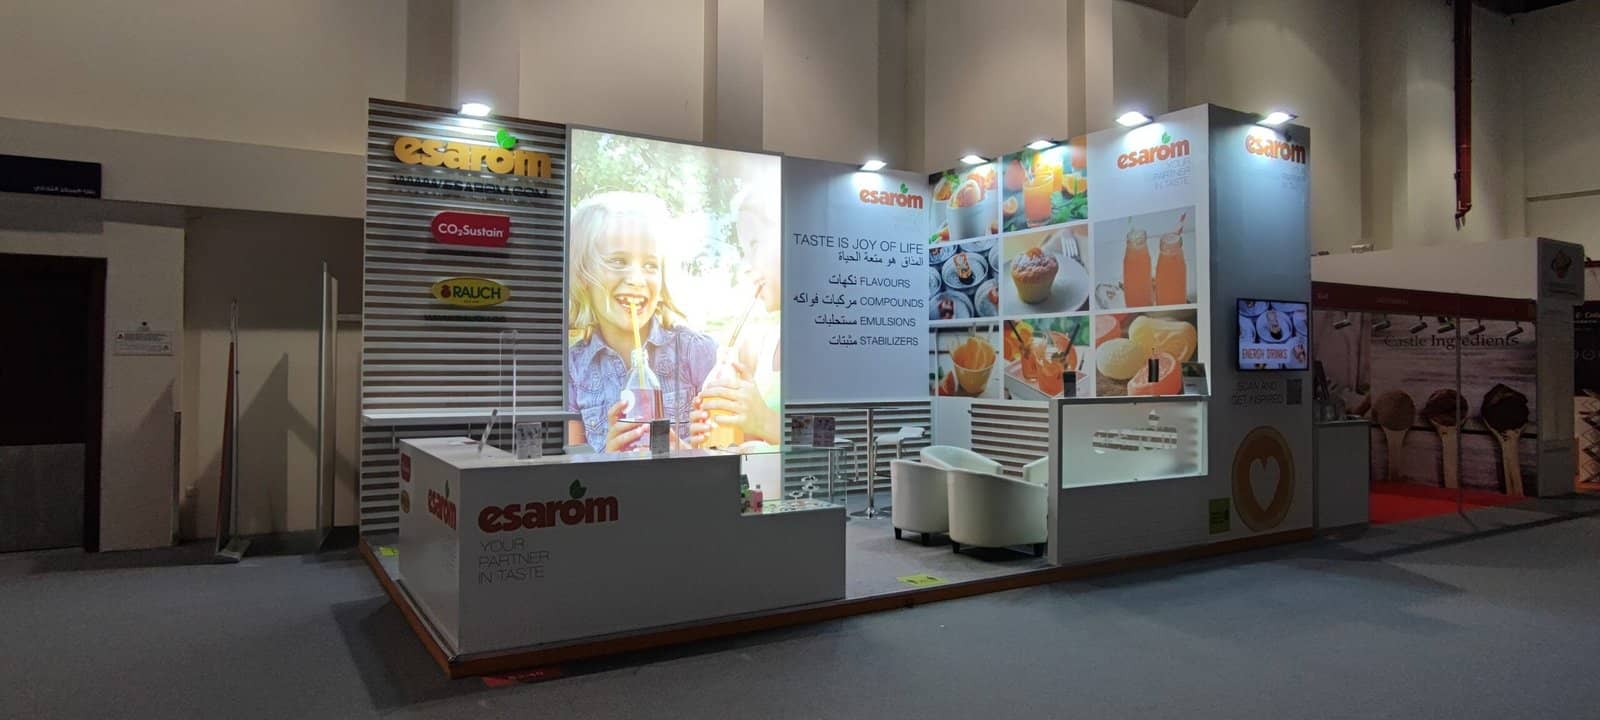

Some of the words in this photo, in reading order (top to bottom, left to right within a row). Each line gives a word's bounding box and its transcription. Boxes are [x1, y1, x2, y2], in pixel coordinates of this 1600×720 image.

[1117, 139, 1190, 169] esarom
[1245, 134, 1306, 164] esarom
[393, 136, 552, 178] esarom
[859, 189, 923, 209] esarom
[793, 233, 834, 247] TASTE
[838, 237, 848, 248] IS
[852, 238, 877, 250] JOY
[880, 240, 896, 251] OF
[900, 242, 923, 254] LIFE
[838, 250, 860, 264] الحياة
[864, 251, 882, 263] متعة
[887, 257, 896, 267] هو
[829, 274, 857, 288] نكهات
[860, 276, 911, 288] FLAVOURS
[453, 286, 502, 299] RAUCH
[793, 292, 819, 307] فواكه
[822, 294, 857, 308] مركبات
[860, 297, 924, 308] COMPOUNDS
[860, 316, 916, 327] EMULSIONS
[860, 336, 919, 346] STABILIZERS
[1384, 335, 1426, 347] Castle
[427, 489, 456, 530] esarom
[478, 496, 619, 533] esarom
[481, 537, 526, 552] YOUR
[478, 551, 550, 569] PARTNER
[479, 571, 493, 585] IN
[499, 565, 545, 581] TASTE
